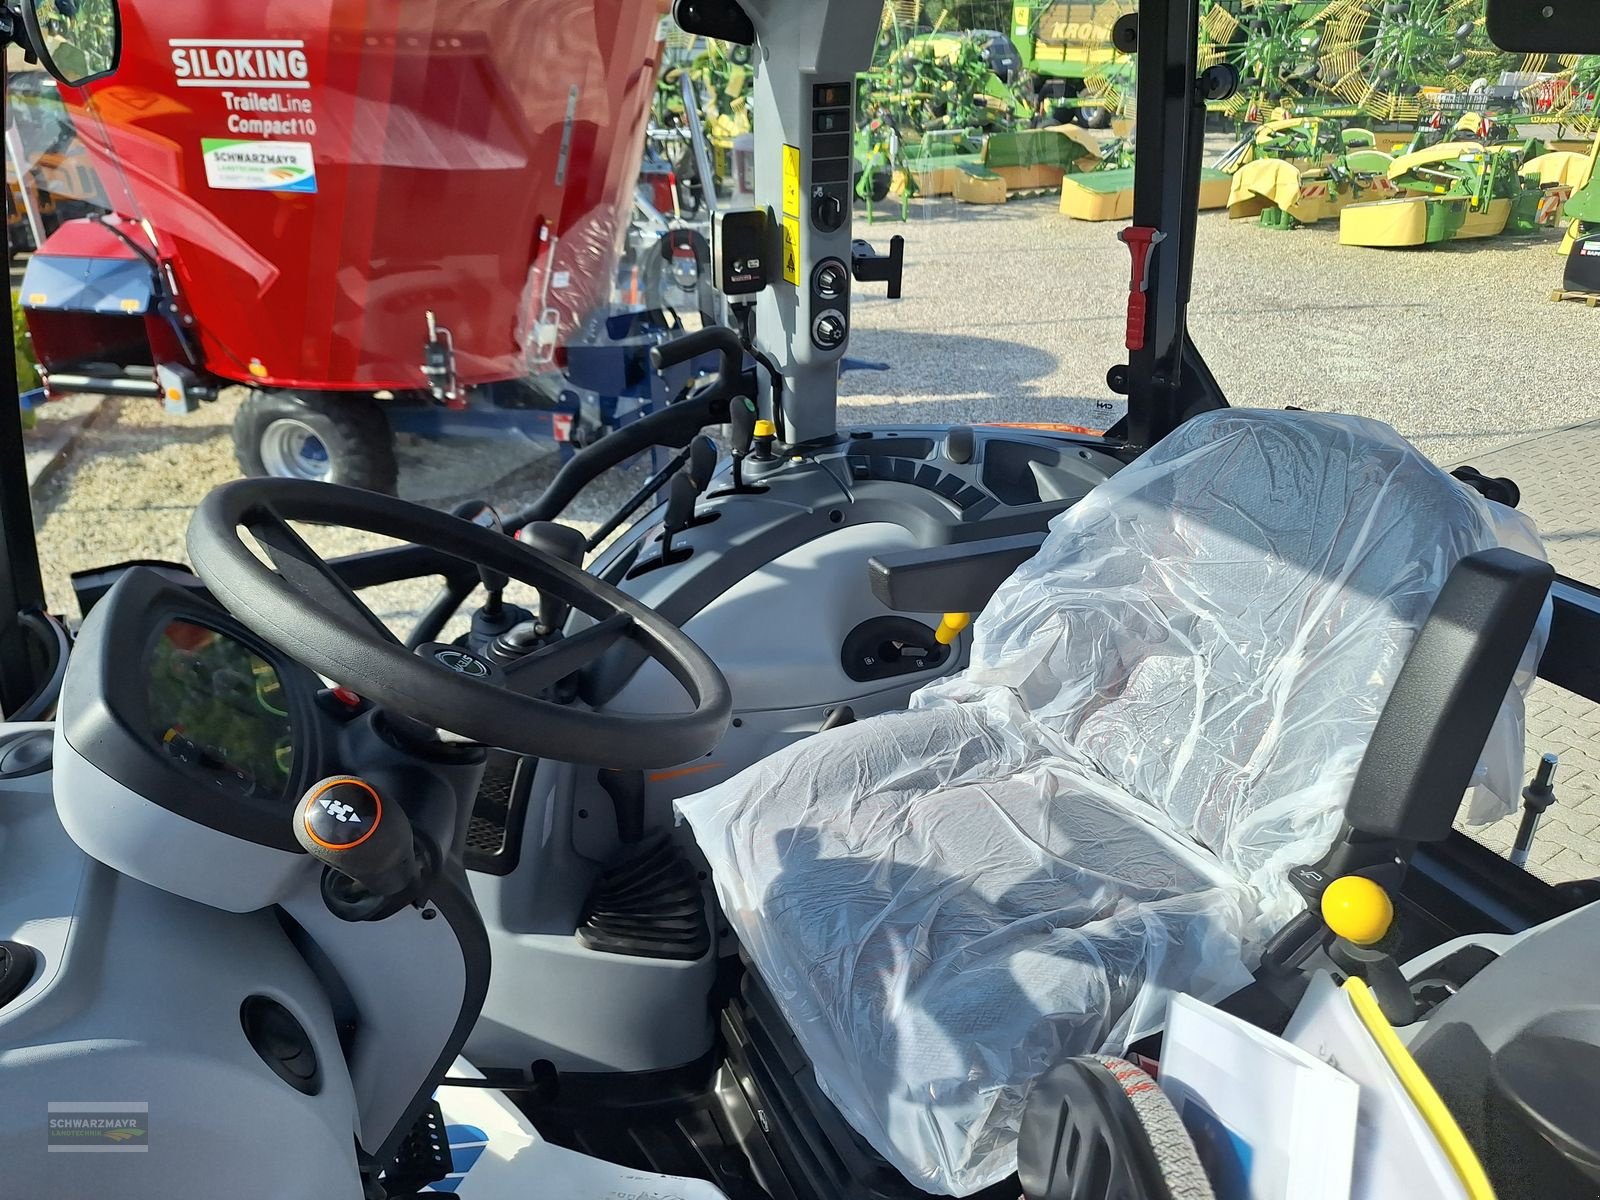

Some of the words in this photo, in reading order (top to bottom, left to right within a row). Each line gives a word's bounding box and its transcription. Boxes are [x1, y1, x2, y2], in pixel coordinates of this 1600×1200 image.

[171, 48, 308, 79] SILOKING
[221, 91, 312, 113] TrailedLine
[213, 152, 297, 164] SCHWARZMAYR
